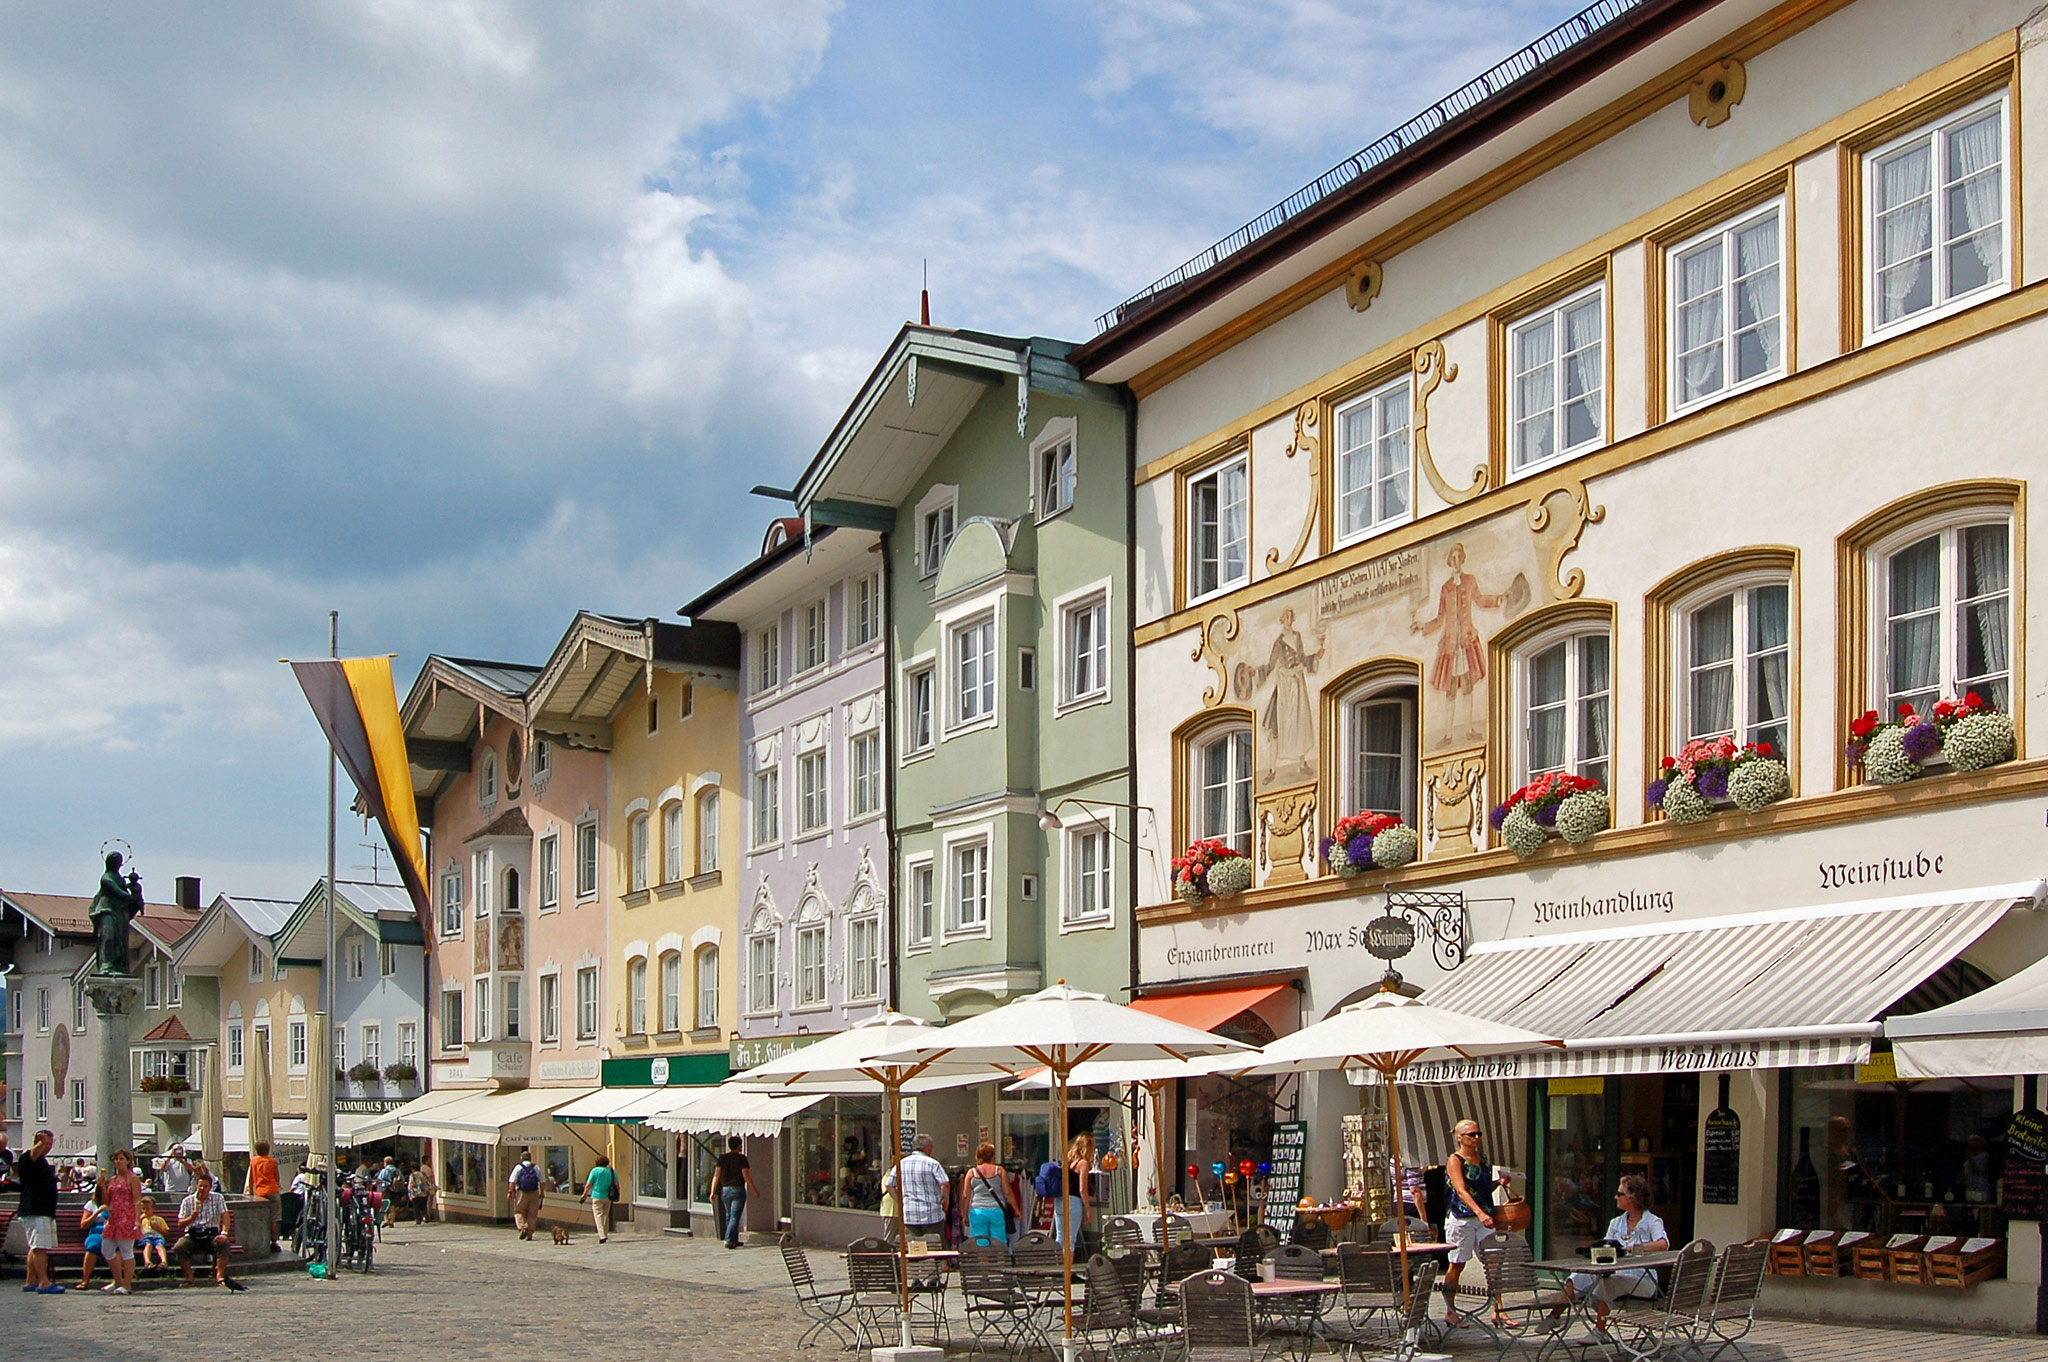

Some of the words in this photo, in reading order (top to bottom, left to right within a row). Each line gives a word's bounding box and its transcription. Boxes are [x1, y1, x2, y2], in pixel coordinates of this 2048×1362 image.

[1533, 888, 1675, 924] Weinhandlung
[1305, 929, 1343, 952] Max
[1369, 927, 1413, 950] Weinhaus
[1167, 938, 1274, 966] Enzianbrennerei
[1395, 1057, 1519, 1081] nzianbrennerei
[1660, 1047, 1759, 1071] Weinhaus
[335, 1101, 381, 1112] STAMMHAUS
[2015, 1114, 2044, 1132] Kleine
